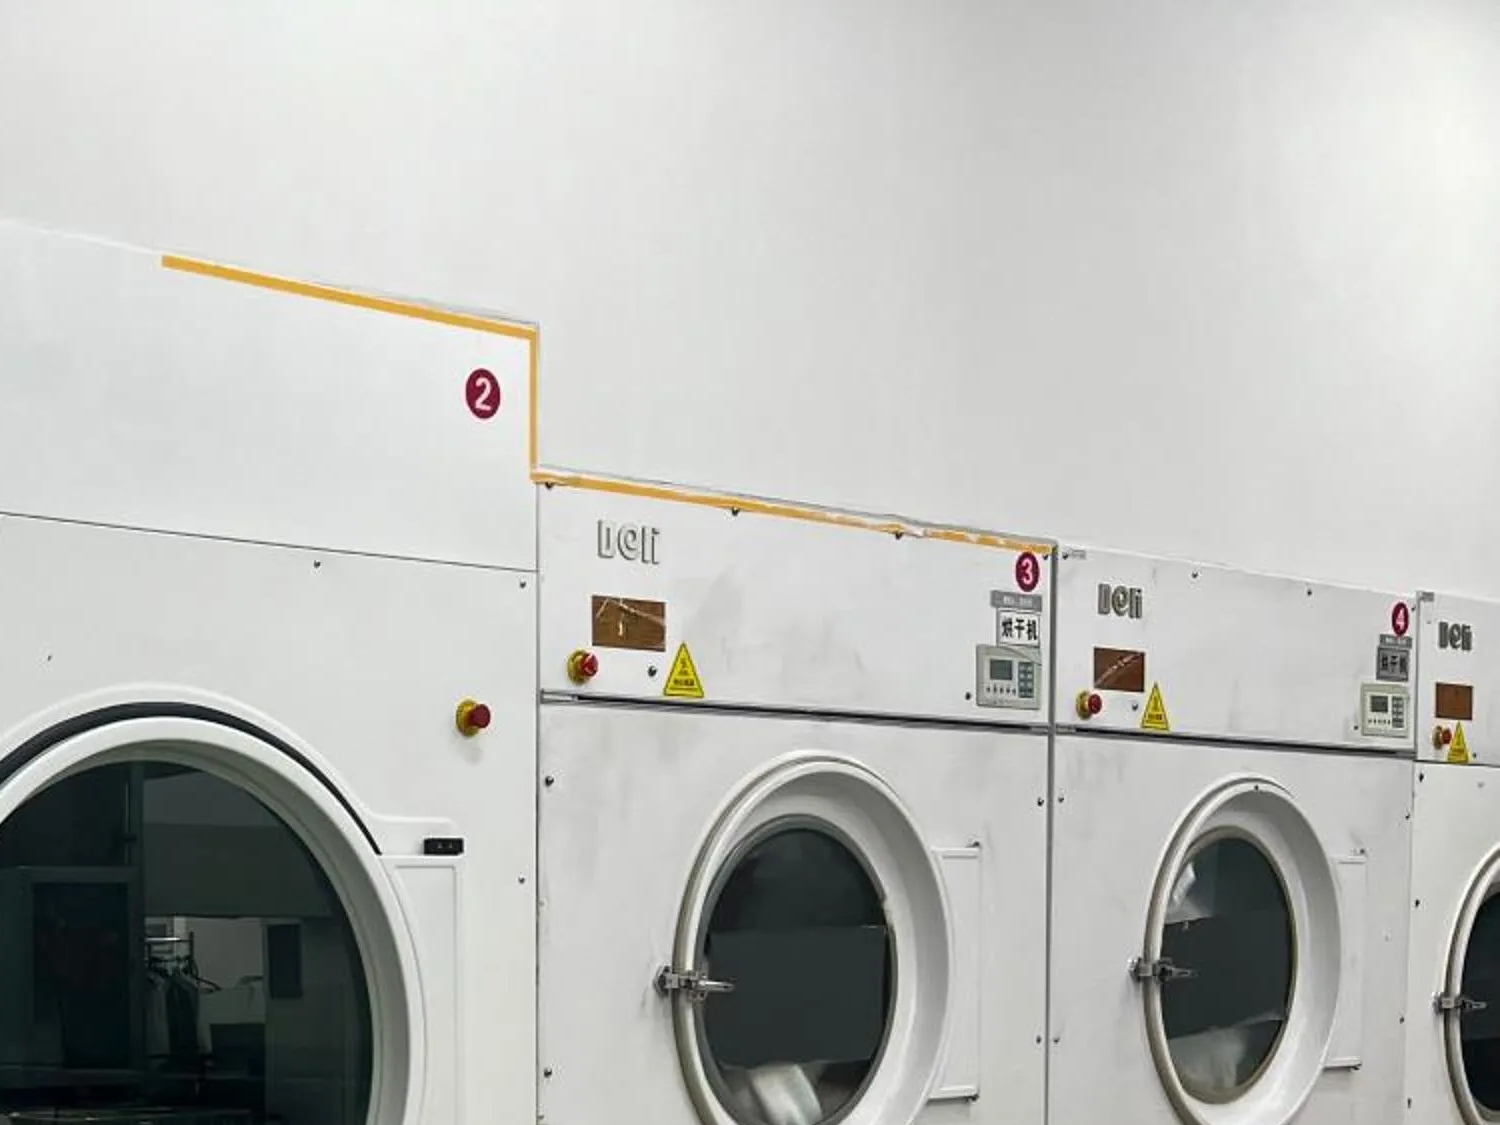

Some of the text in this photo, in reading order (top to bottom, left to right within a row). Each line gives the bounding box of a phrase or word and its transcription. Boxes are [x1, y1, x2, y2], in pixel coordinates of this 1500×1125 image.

[475, 377, 492, 410] 2
[1022, 558, 1033, 585] 3
[1001, 616, 1038, 640] 烘干机
[1396, 607, 1405, 631] 4
